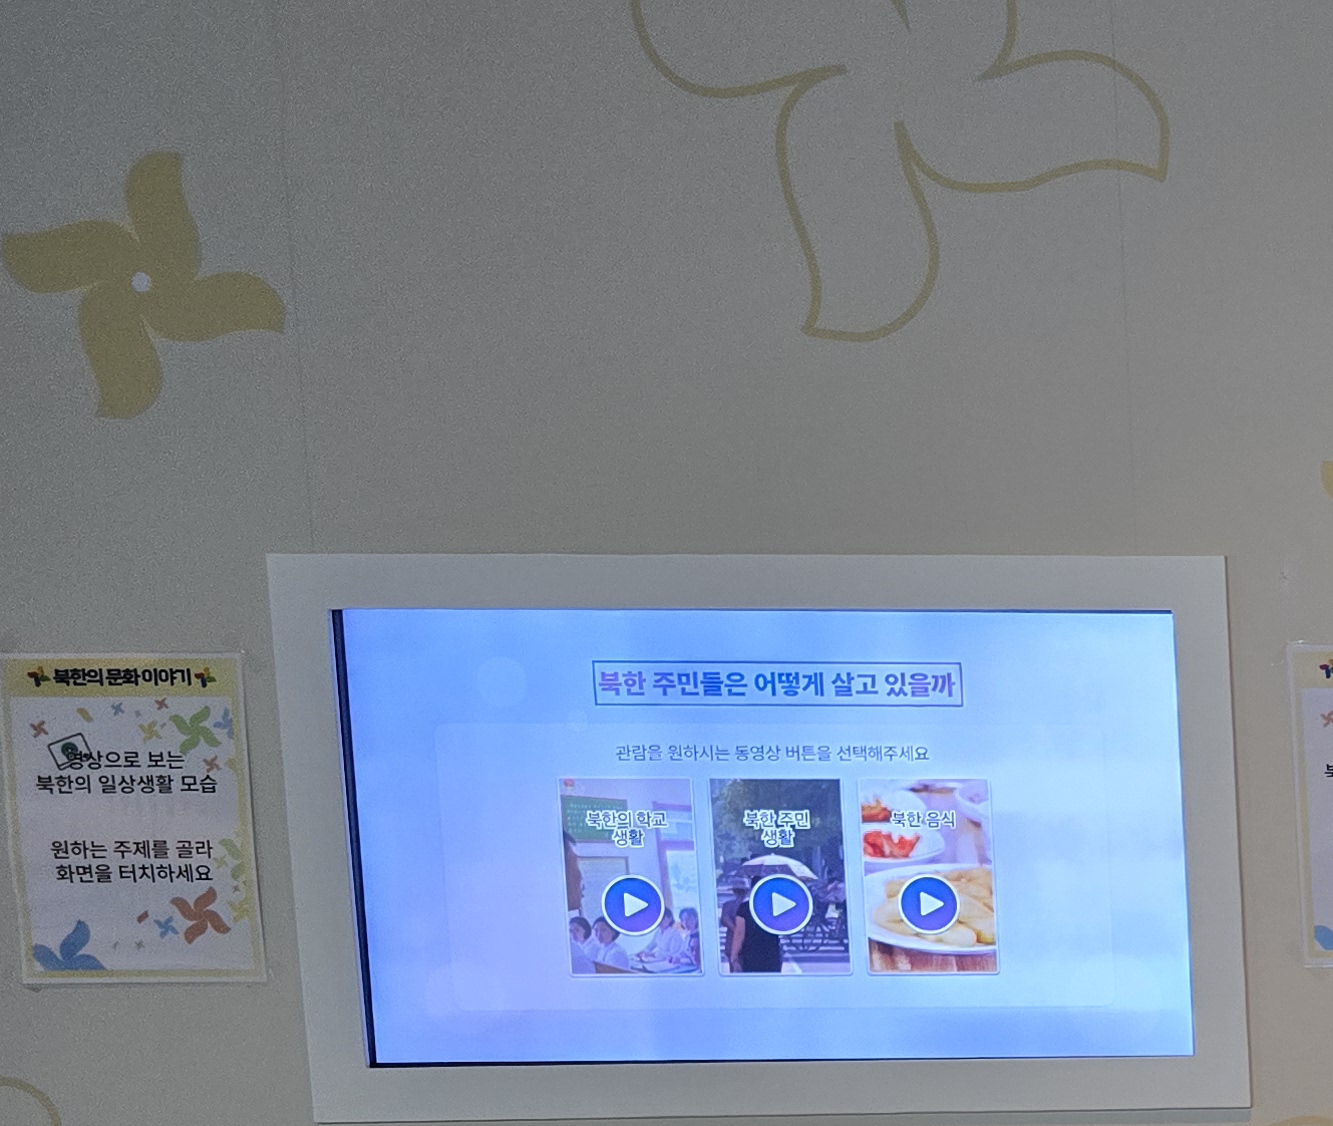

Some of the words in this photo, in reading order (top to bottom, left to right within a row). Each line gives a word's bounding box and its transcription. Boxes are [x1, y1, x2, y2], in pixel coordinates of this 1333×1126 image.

[53, 668, 104, 686] 북한의
[106, 668, 140, 685] 문화
[143, 668, 192, 686] 이야기
[598, 671, 646, 697] 북한
[653, 671, 748, 697] 주민들은
[754, 672, 825, 698] 어떻게
[831, 672, 879, 698] 살고
[884, 672, 956, 698] 있을까
[68, 751, 141, 770] 영상으로
[147, 751, 186, 770] 보는
[615, 745, 663, 762] 관람을
[668, 745, 731, 762] 원하시는
[735, 745, 781, 762] 동영상
[785, 745, 832, 762] 버튼을
[836, 745, 929, 762] 선택해주세요
[35, 775, 92, 794] 북한의
[98, 775, 174, 794] 일상생활
[180, 775, 218, 794] 모습
[587, 811, 632, 829] 북한의
[636, 811, 669, 828] 학교
[744, 810, 776, 828] 북한
[779, 810, 811, 828] 주민
[891, 811, 922, 828] 북한
[926, 811, 957, 828] 음식
[613, 829, 645, 847] 생활
[762, 829, 794, 847] 생활
[50, 840, 107, 860] 원하는
[113, 840, 170, 859] 주제를
[175, 840, 214, 859] 골라
[55, 864, 112, 884] 화면을
[118, 864, 214, 884] 터치하세요
